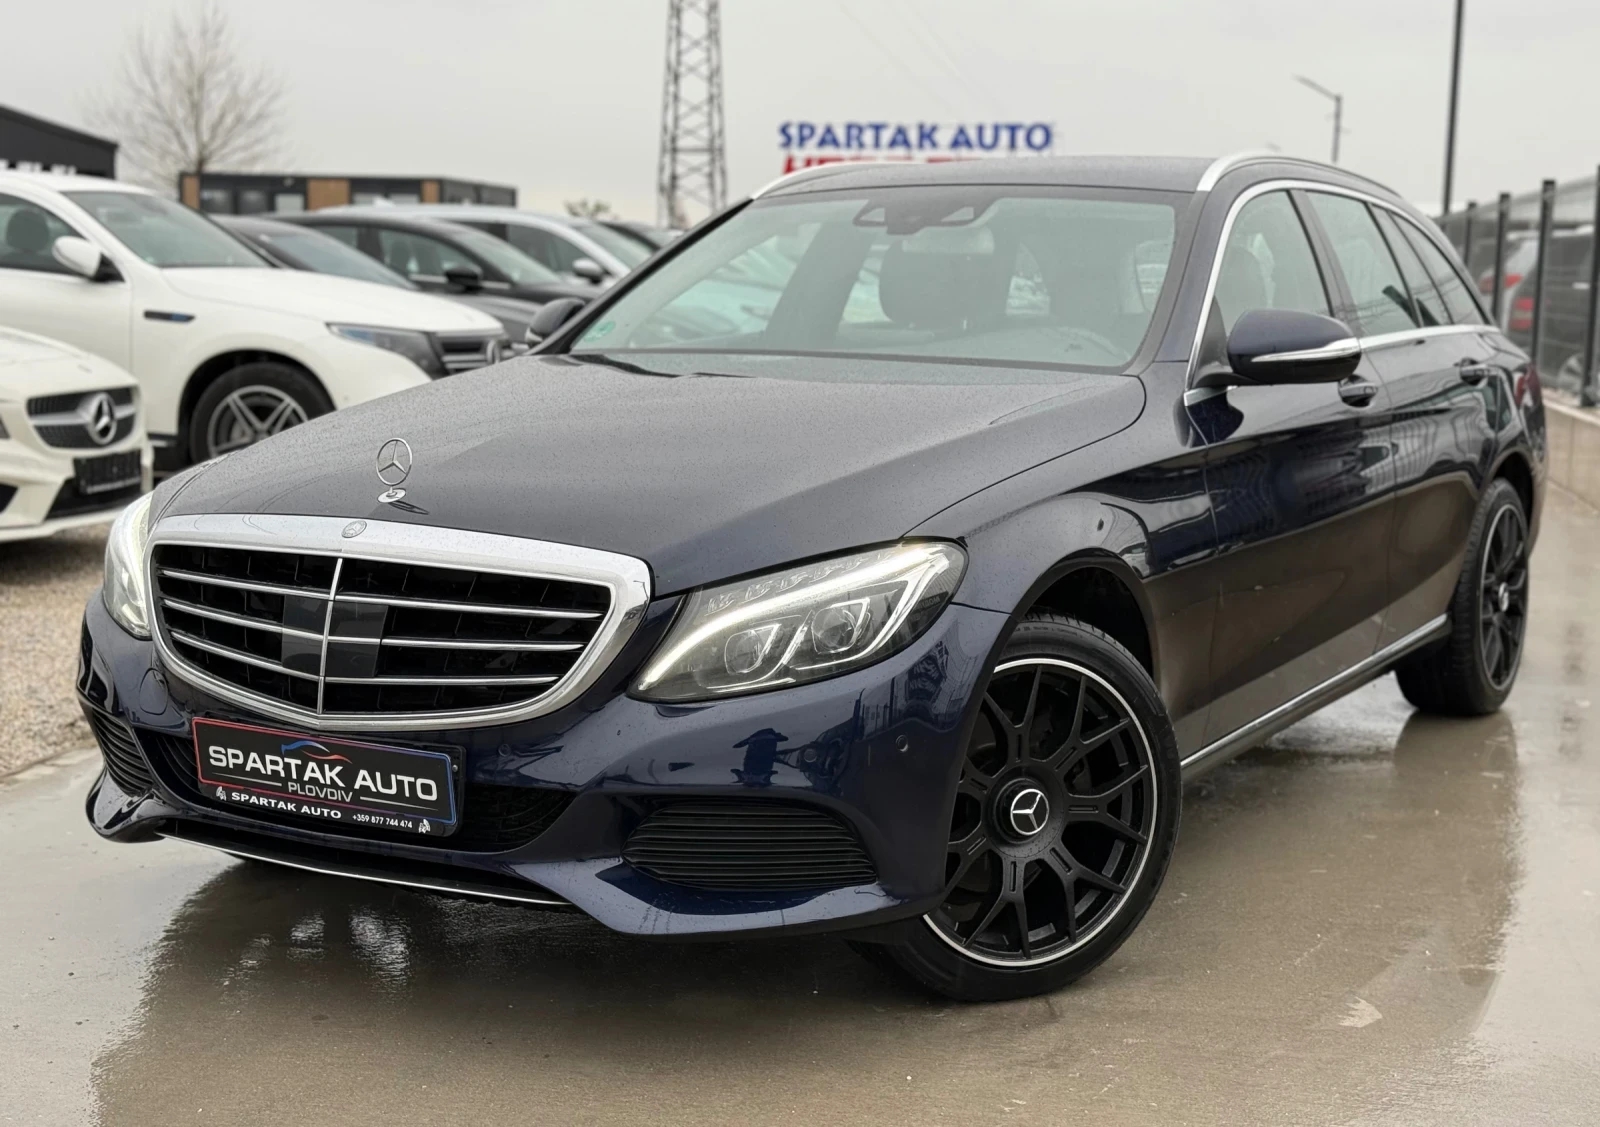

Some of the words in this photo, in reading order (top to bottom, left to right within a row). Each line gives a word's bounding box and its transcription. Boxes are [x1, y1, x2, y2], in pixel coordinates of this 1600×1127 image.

[779, 122, 938, 149] SPARTAK
[949, 123, 1053, 150] AUTO
[208, 745, 346, 787] SPARTAK
[354, 769, 438, 801] AUTO
[231, 791, 297, 812] SPARTAK
[301, 805, 342, 819] AUTO
[288, 782, 353, 802] PLOVDIV
[352, 813, 370, 823] +359
[371, 815, 384, 825] 877
[386, 817, 399, 827] 744
[400, 819, 413, 829] 474
